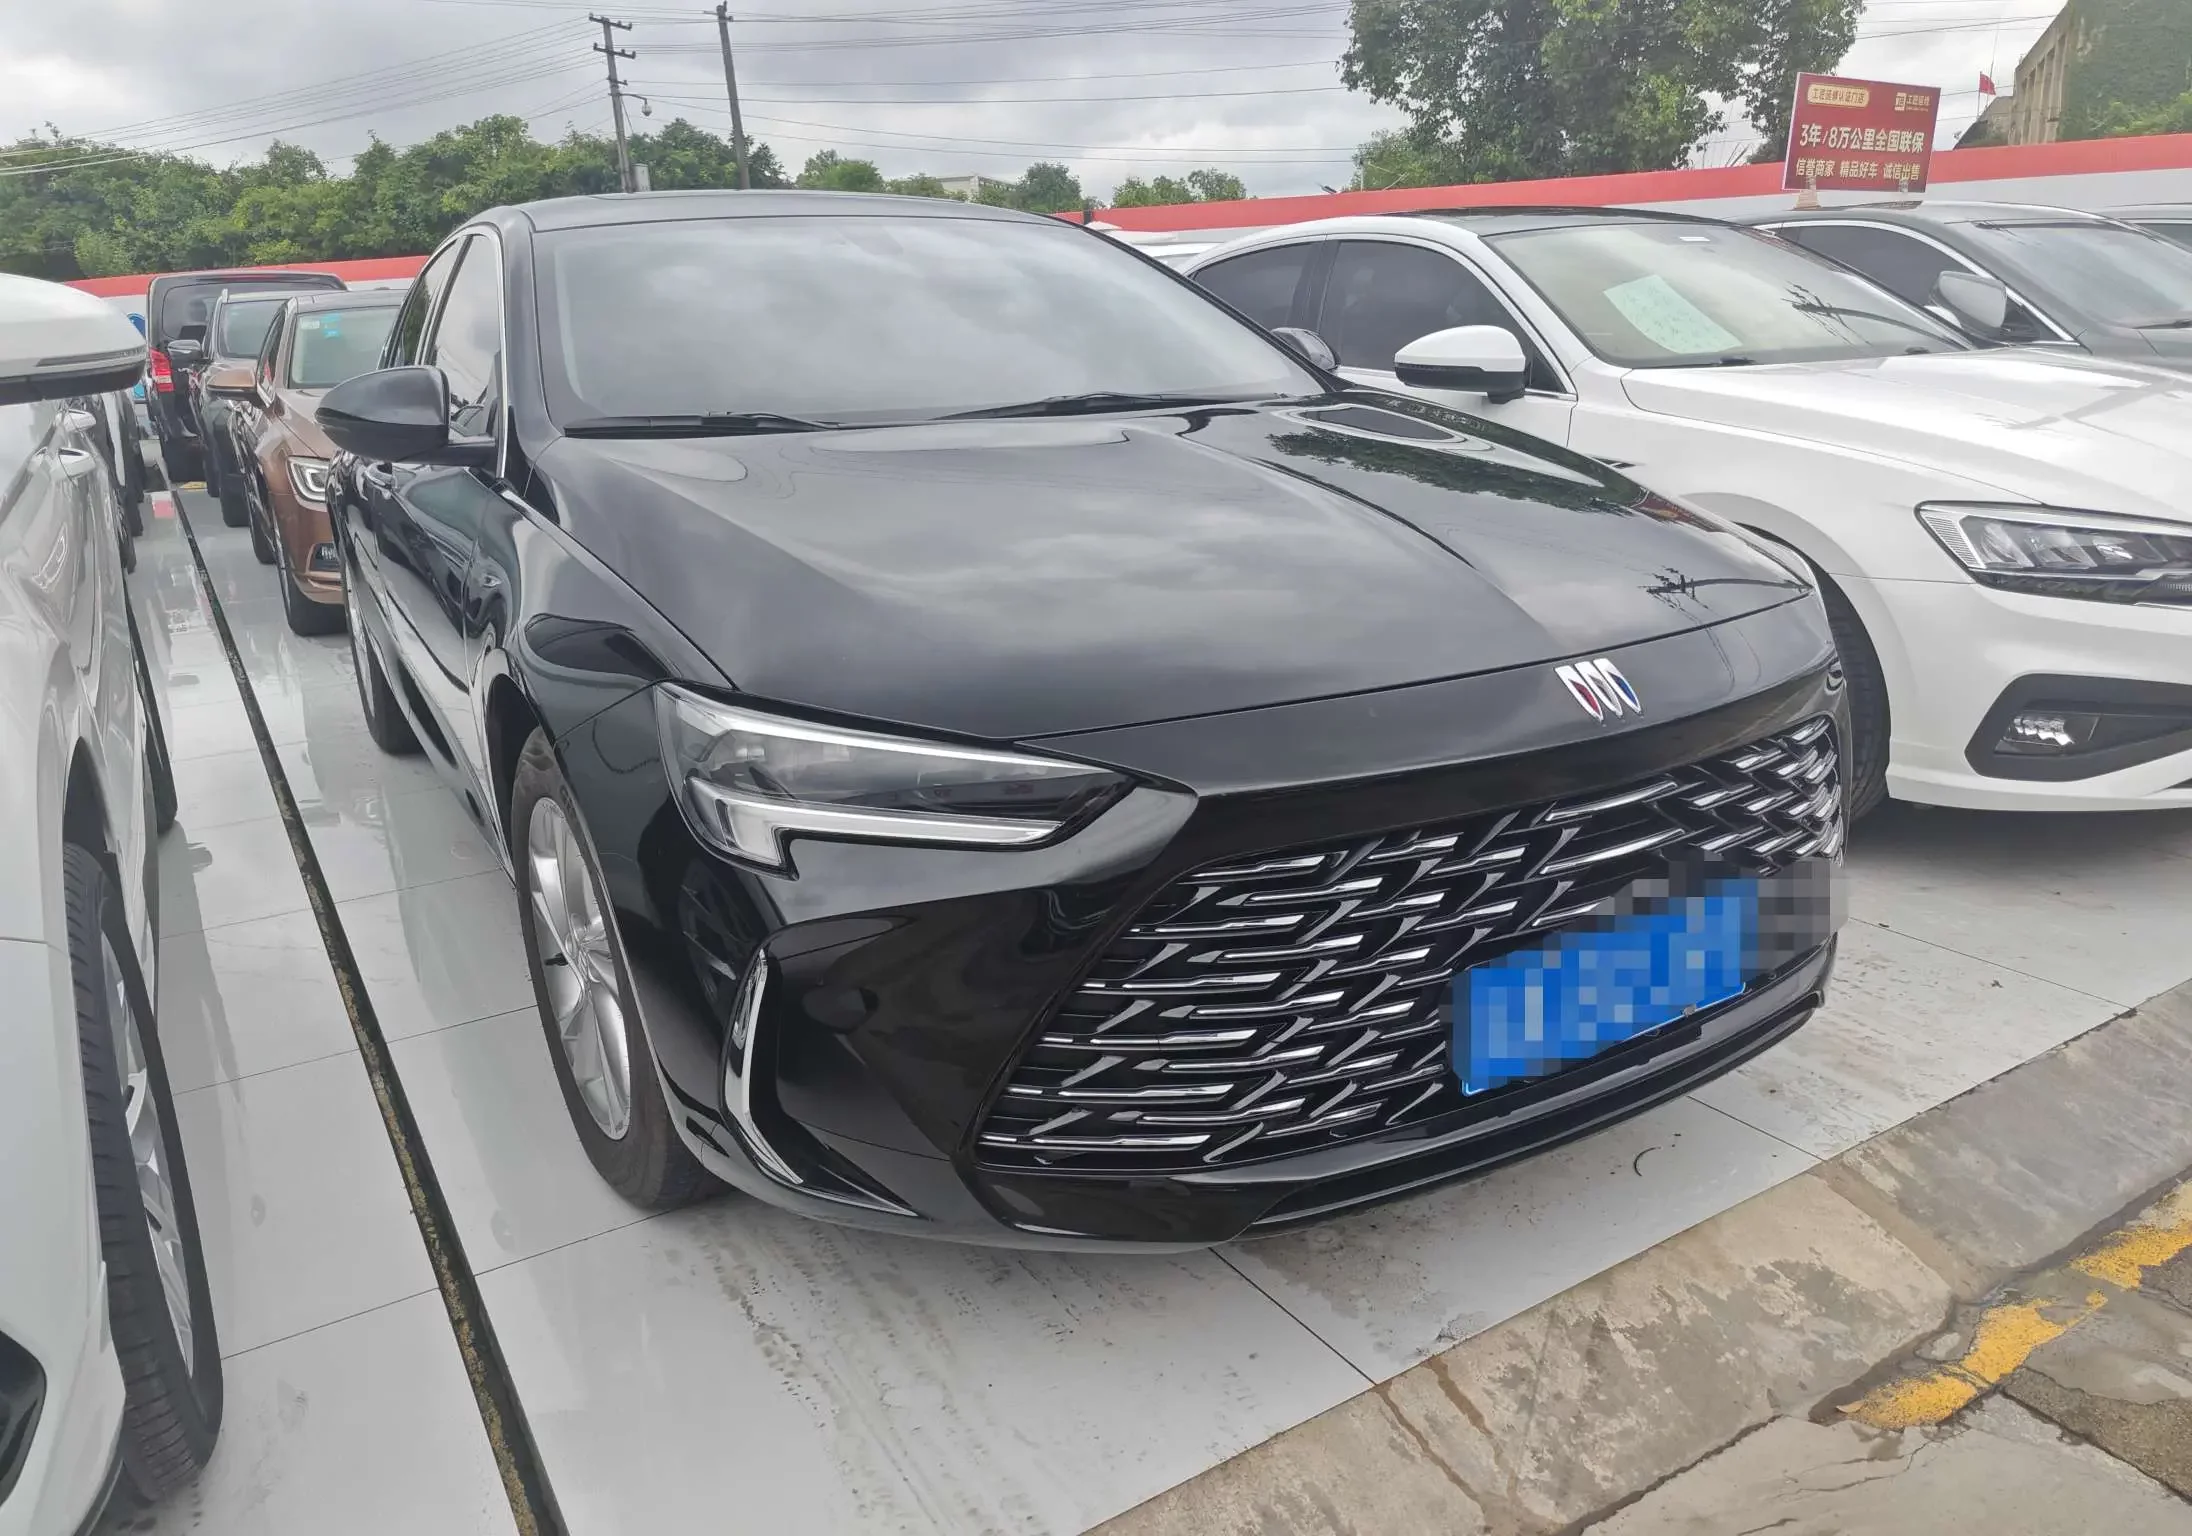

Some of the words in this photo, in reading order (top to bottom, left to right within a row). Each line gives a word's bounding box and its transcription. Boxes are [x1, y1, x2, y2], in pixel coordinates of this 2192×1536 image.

[1799, 123, 1924, 153] 3年/8万公里全国联保
[1796, 158, 1835, 177] 信誉商家
[1840, 159, 1878, 178] 精品好车
[1883, 162, 1920, 181] 诚信出售
